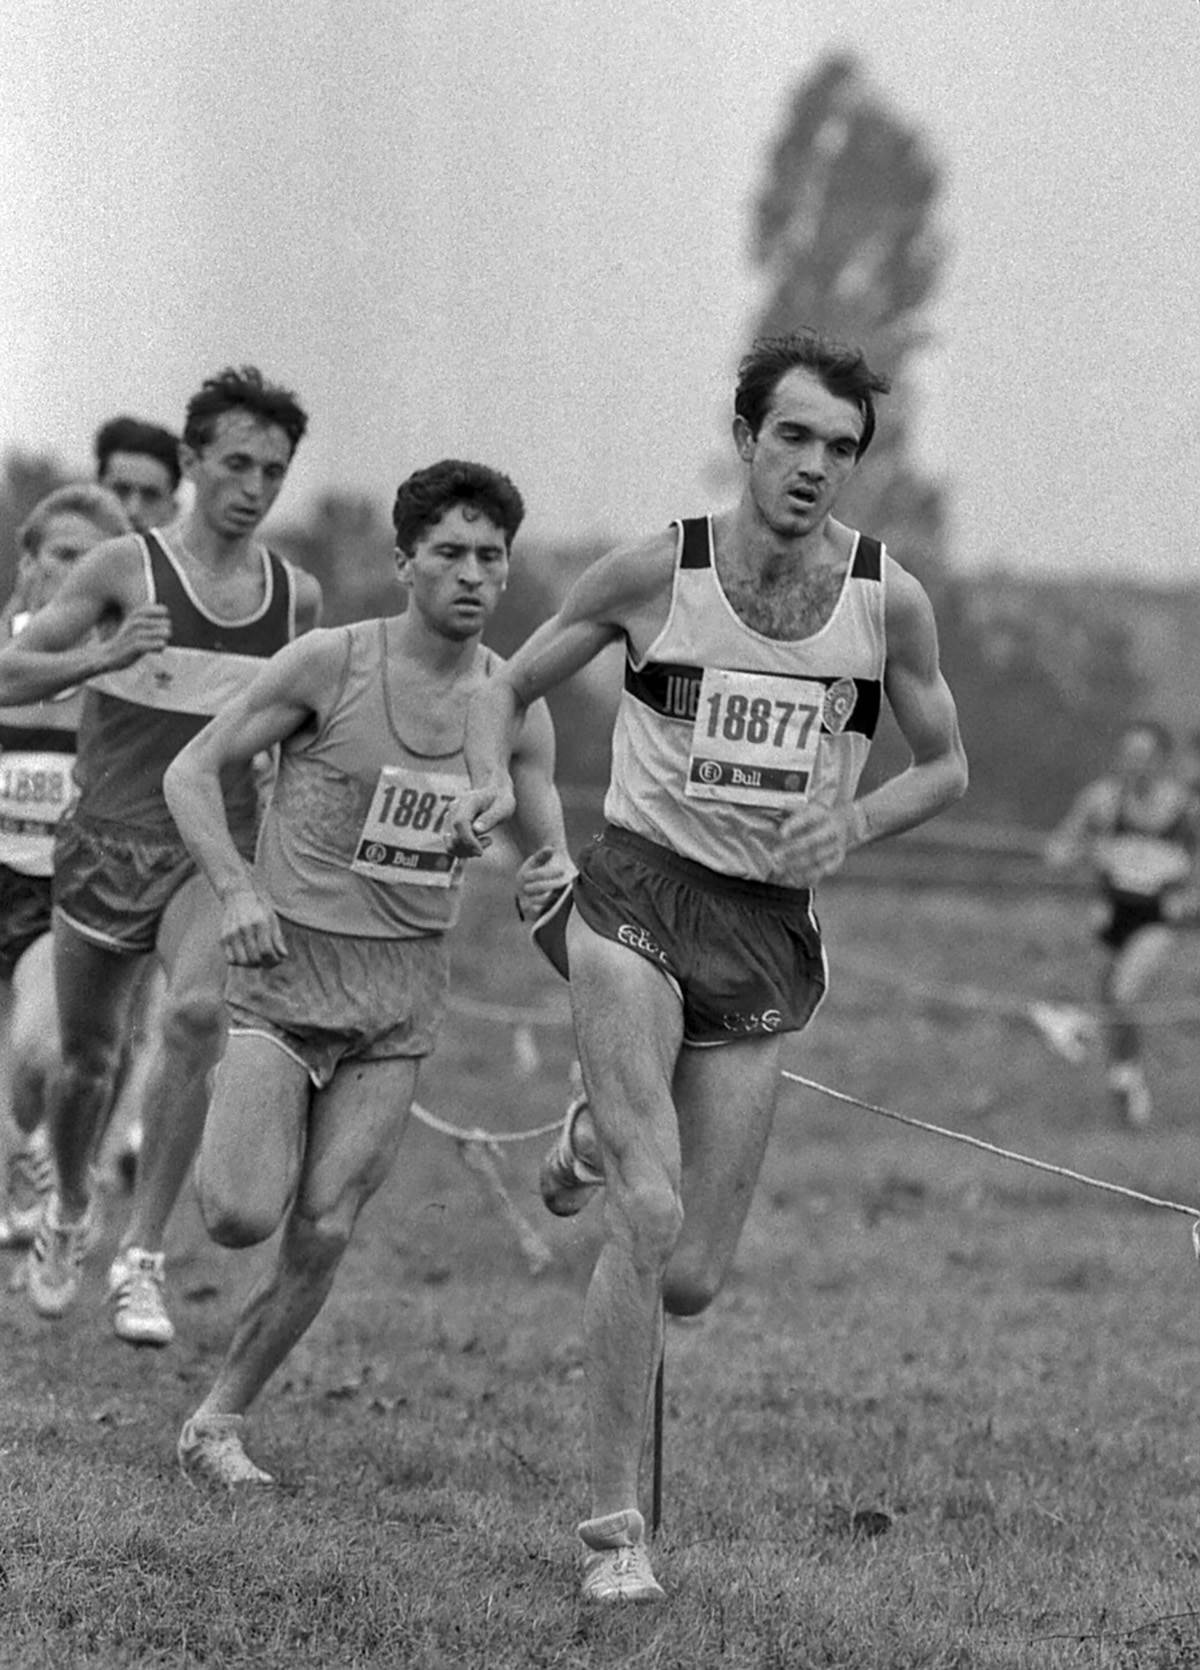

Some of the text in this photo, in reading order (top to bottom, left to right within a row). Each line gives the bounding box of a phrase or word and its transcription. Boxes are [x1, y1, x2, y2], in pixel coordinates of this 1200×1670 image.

[706, 692, 818, 750] 18877
[732, 767, 761, 786] Bull
[392, 850, 420, 868] Bull
